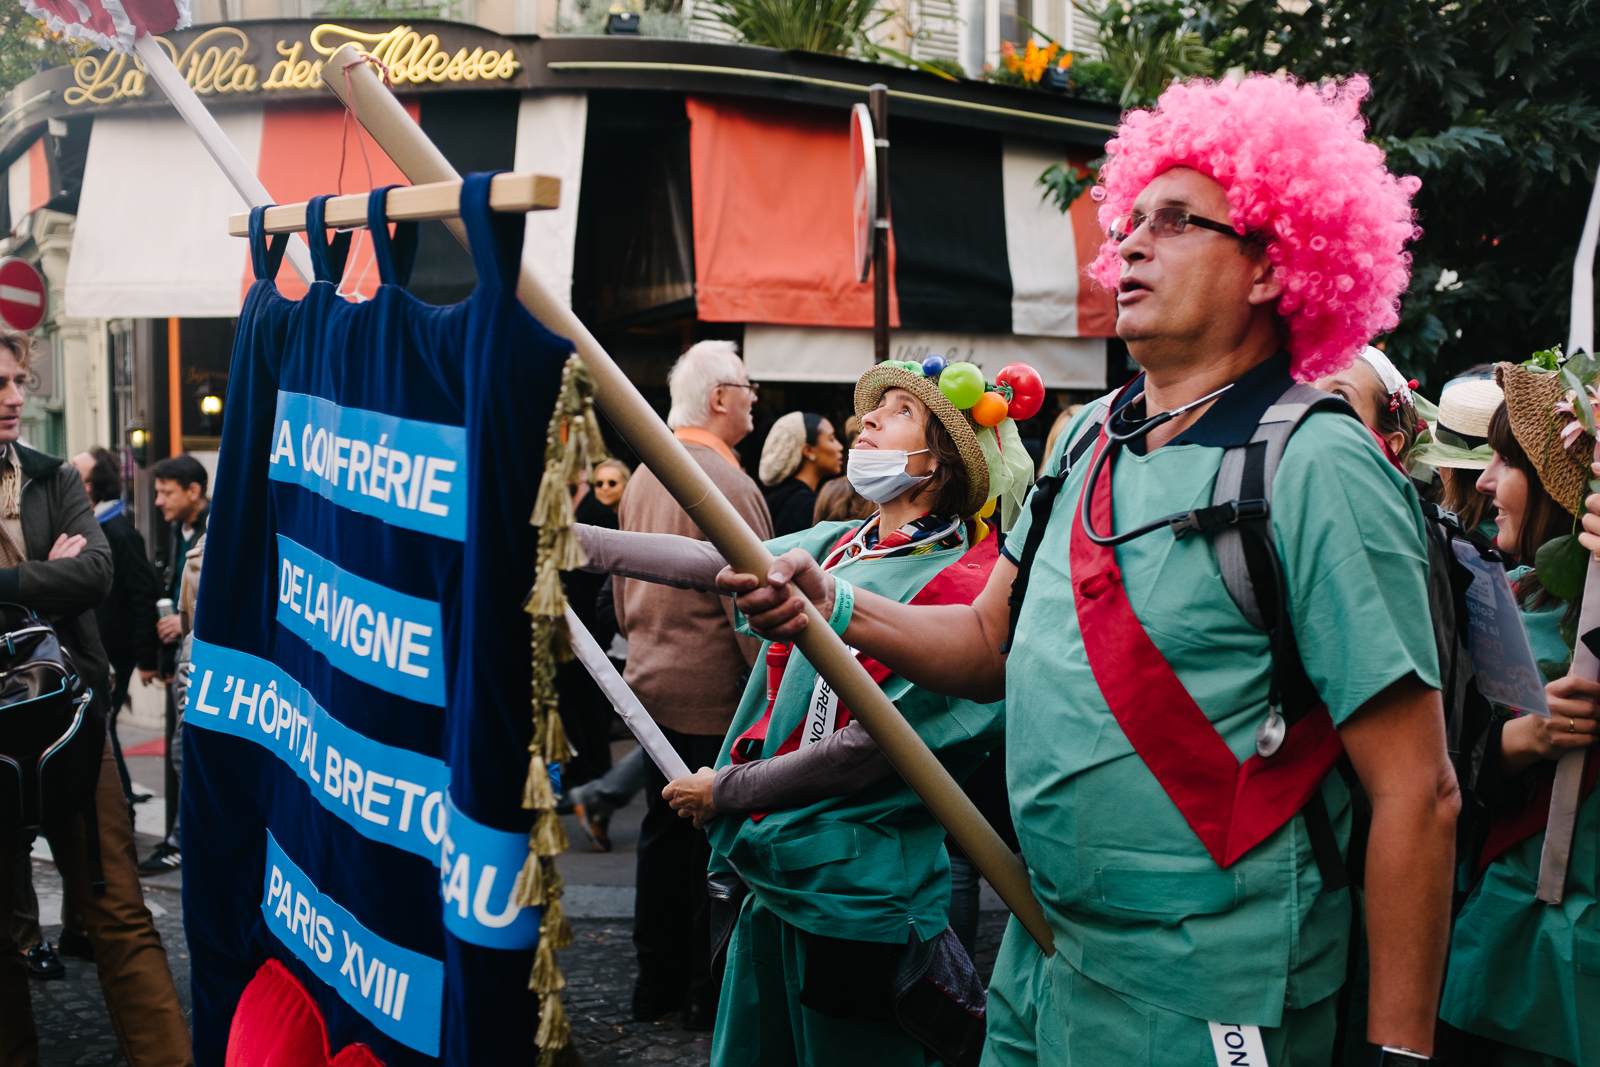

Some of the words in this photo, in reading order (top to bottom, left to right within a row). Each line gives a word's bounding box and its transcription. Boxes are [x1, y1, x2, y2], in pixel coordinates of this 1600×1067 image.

[64, 48, 147, 105] La
[133, 26, 258, 94] Villa
[262, 39, 325, 90] des
[310, 23, 521, 85] Abbesses
[269, 419, 296, 467] A
[302, 423, 457, 518] CONFRÉRIE
[279, 557, 305, 615] DE
[267, 864, 335, 963] PARIS
[340, 930, 409, 1021] XVIII
